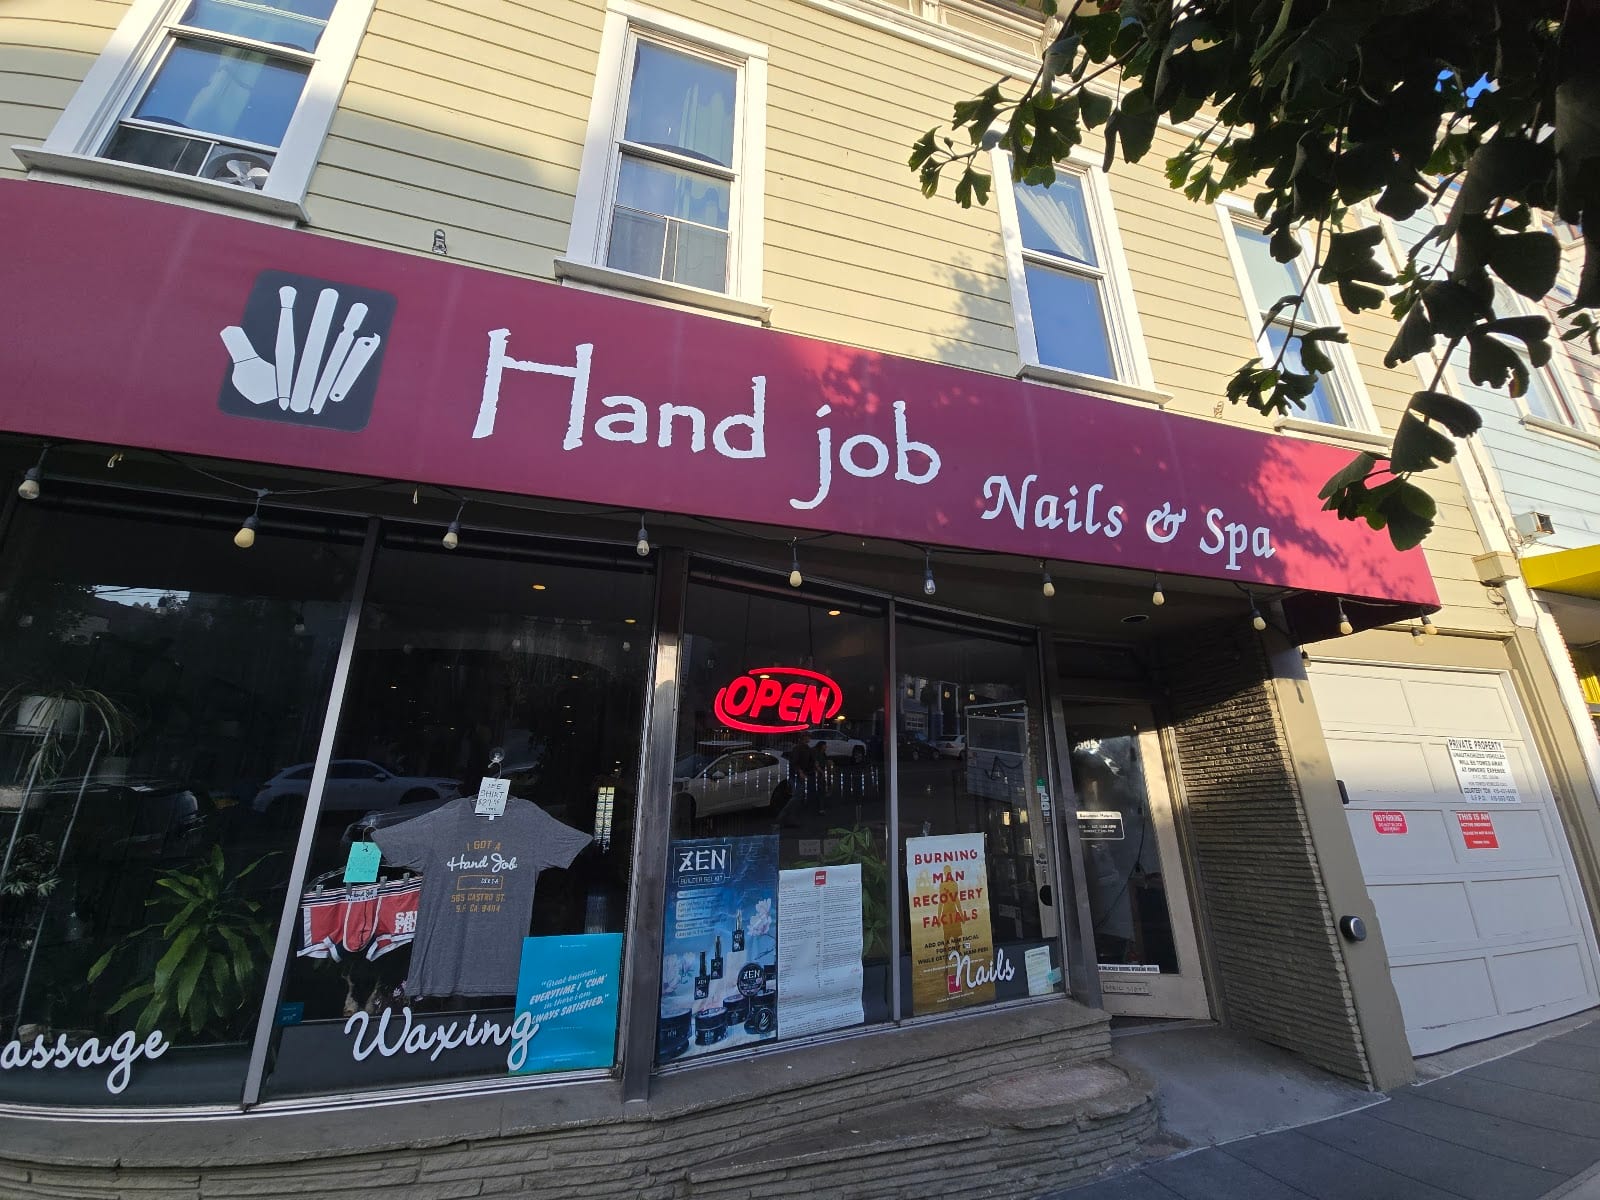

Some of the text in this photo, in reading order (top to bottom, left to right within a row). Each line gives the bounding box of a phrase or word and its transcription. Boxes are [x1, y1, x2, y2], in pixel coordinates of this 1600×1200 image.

[471, 327, 942, 510] Hand job
[980, 474, 1277, 571] Nails & Spa
[724, 676, 830, 724] OPEN
[1447, 739, 1503, 750] PRIVATE PROPERTY
[473, 840, 492, 850] GOT
[446, 852, 518, 873] Hand Job
[678, 849, 727, 873] ZEN
[914, 849, 978, 865] BURNING
[932, 870, 965, 884] MAN
[467, 893, 494, 902] CASTRO
[913, 888, 983, 908] RECOVERY
[922, 909, 978, 929] FACIALS
[743, 969, 761, 980] ZEN
[947, 947, 1017, 989] Nails
[529, 983, 576, 1005] EVERYTIME
[531, 1008, 560, 1025] LWAYS
[343, 1006, 540, 1071] Waxing
[0, 1030, 170, 1094] assage
